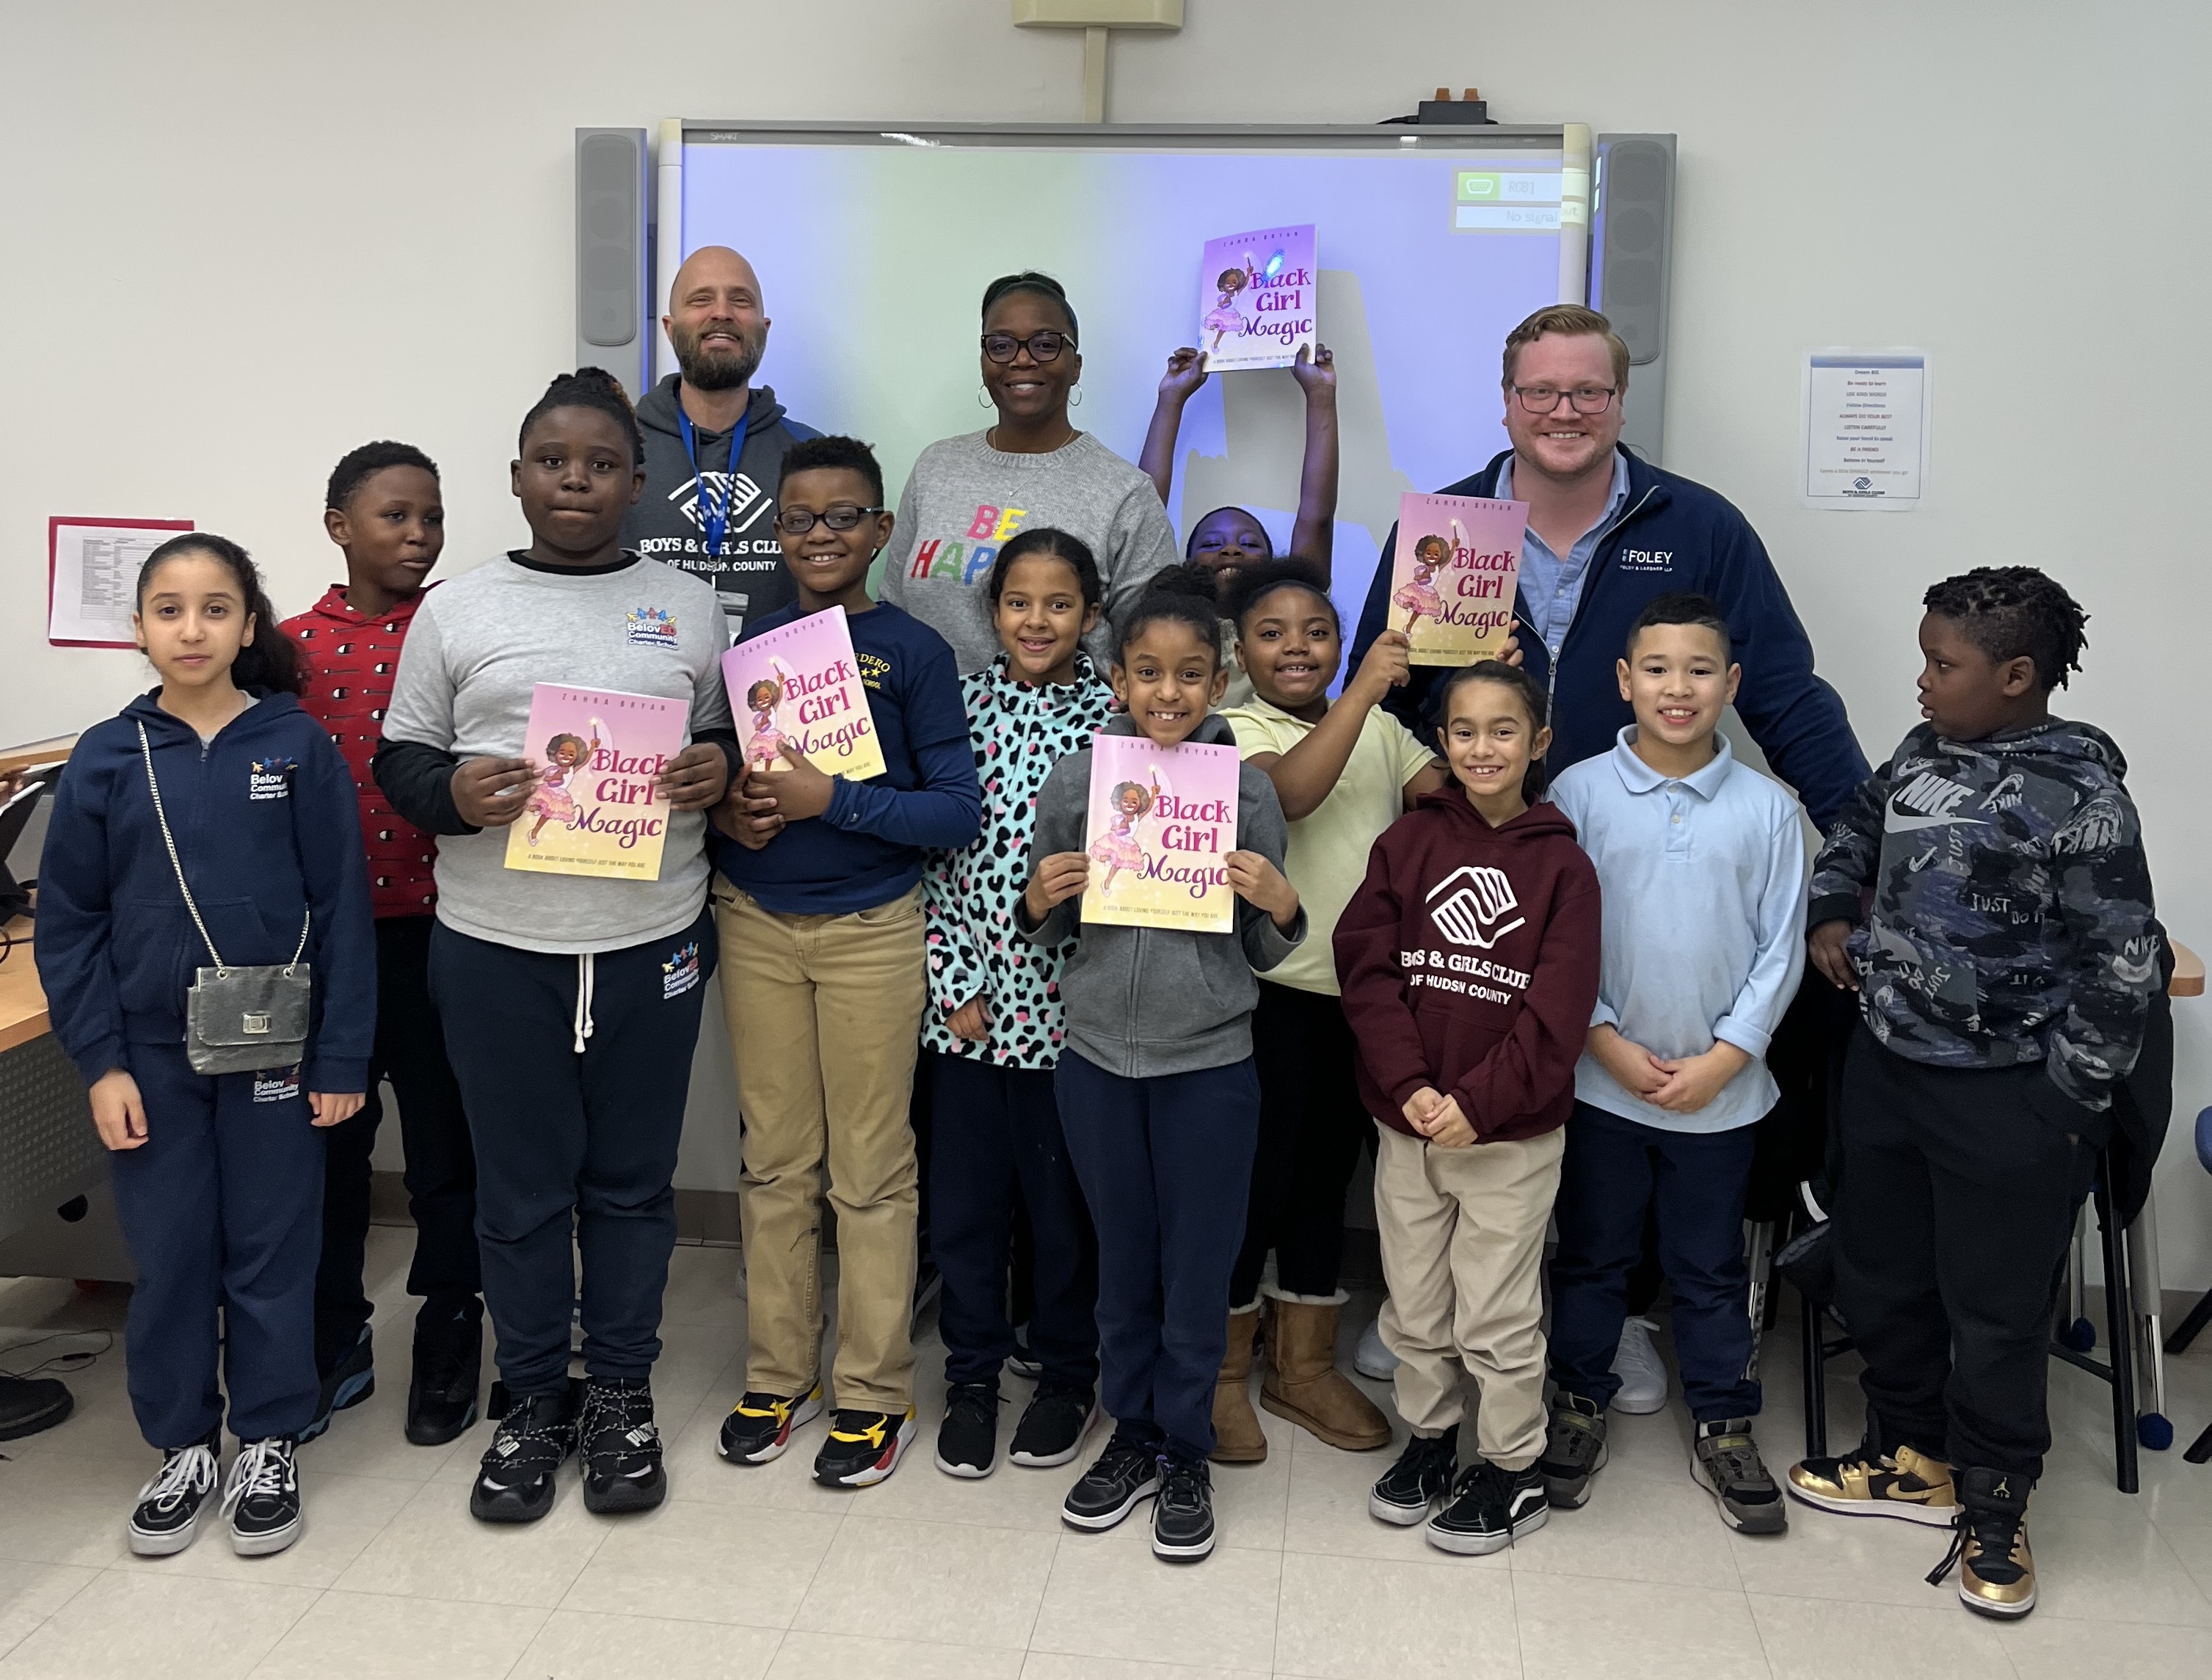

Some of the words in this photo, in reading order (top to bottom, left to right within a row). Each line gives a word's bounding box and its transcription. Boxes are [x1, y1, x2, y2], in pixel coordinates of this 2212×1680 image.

[1507, 211, 1521, 222] No
[1525, 211, 1557, 224] signal
[1256, 290, 1300, 311] Girl
[1238, 316, 1312, 345] Magic
[967, 504, 1026, 541] BE
[640, 538, 682, 553] BOYS
[685, 539, 699, 553] &
[753, 539, 784, 553] CLU
[1629, 550, 1673, 564] FOLEY
[733, 561, 776, 571] COUNTY
[911, 539, 997, 586] HAP
[1454, 548, 1515, 571] Black
[1458, 575, 1503, 598] Girl
[627, 622, 677, 636] BelovED
[1435, 600, 1508, 639] Magic
[628, 631, 677, 643] Community
[784, 660, 854, 701] Black
[799, 686, 851, 724] Girl
[789, 717, 870, 757] Magic
[1121, 741, 1165, 752] ZAHRA
[1176, 746, 1218, 757] BRYAN
[596, 778, 655, 804] Girl
[1896, 771, 1976, 817] NIKE
[1156, 796, 1231, 823] Black
[567, 804, 662, 848] Magic
[1162, 825, 1218, 853] Girl
[1948, 825, 1963, 870] JUST
[1137, 852, 1229, 898] Magic
[1971, 892, 2011, 913] JUST
[2012, 911, 2029, 925] DO
[2125, 934, 2160, 956] NIKE
[1429, 950, 1445, 968] &
[1448, 954, 1492, 978] GRLS
[1427, 974, 1466, 993] HUDSN
[1469, 984, 1511, 1005] COUNTY
[1925, 967, 1951, 1000] JUST
[496, 1435, 520, 1458] MA
[625, 1421, 655, 1447] PUM
